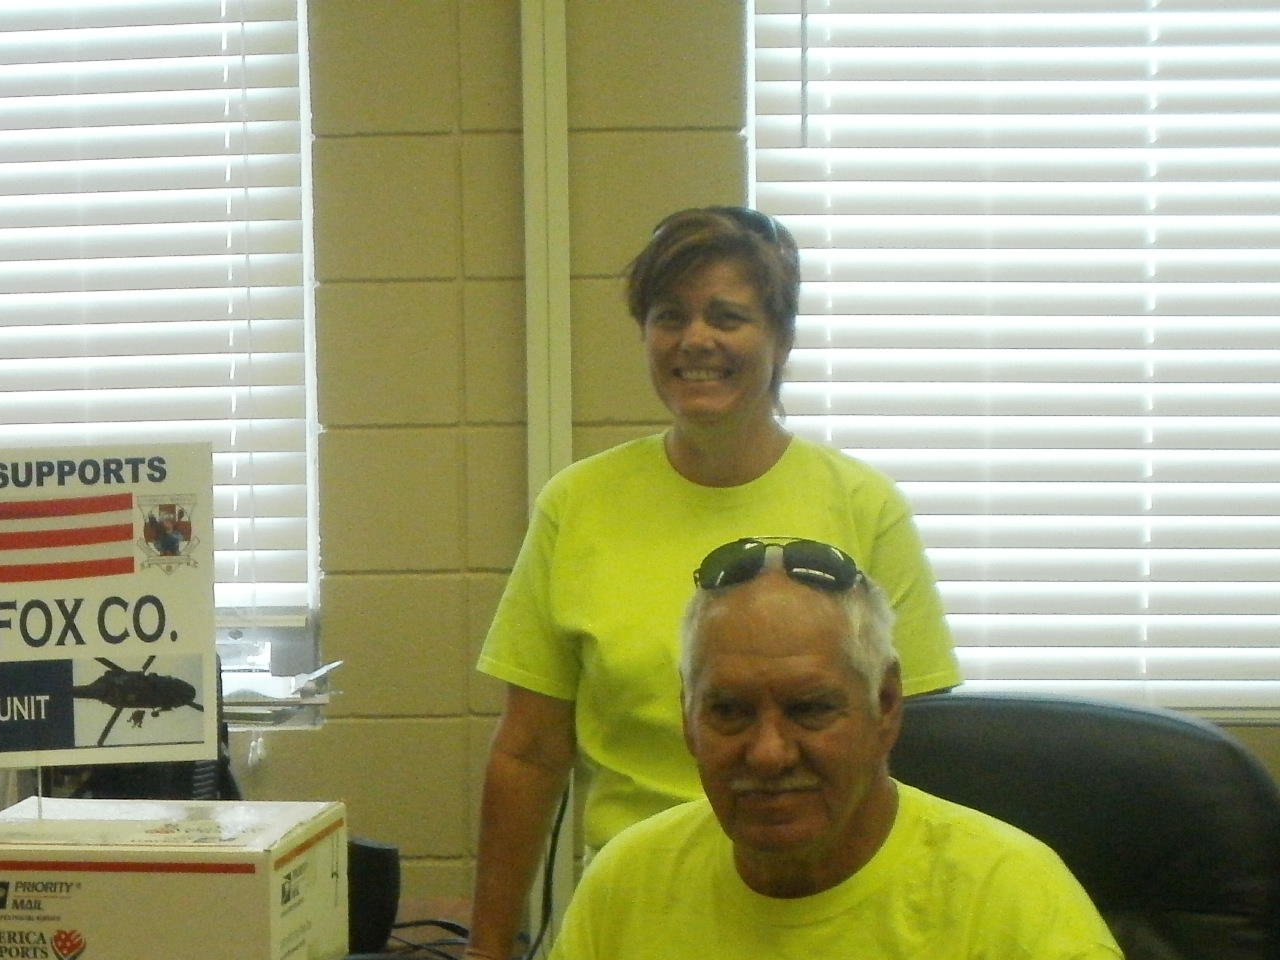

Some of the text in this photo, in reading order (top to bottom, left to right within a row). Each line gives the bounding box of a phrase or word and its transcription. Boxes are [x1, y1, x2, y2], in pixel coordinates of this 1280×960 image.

[98, 595, 179, 643] CO.
[14, 881, 73, 893] PRIORITY
[12, 899, 44, 910] MAIL
